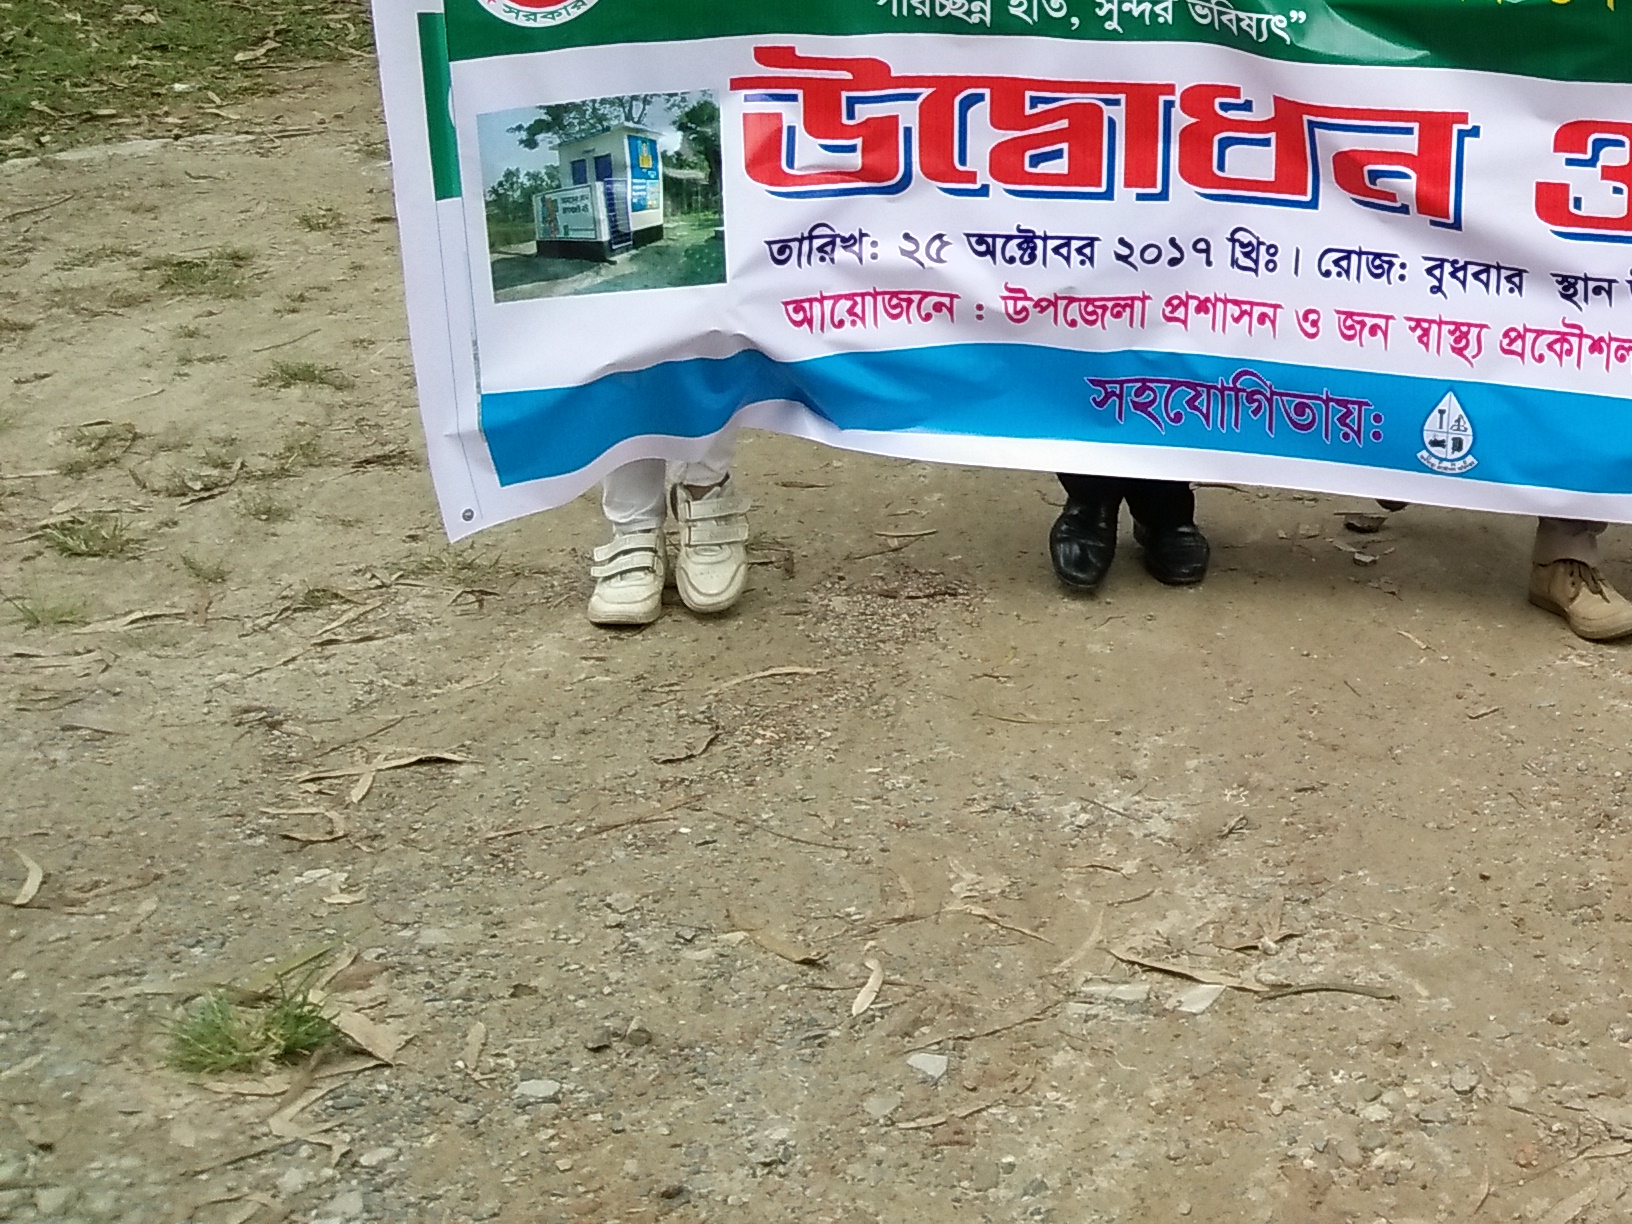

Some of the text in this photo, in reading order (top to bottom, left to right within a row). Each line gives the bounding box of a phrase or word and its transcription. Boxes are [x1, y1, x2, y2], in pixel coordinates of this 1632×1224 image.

[728, 44, 1482, 232] উদ্বোধন
[764, 225, 880, 274] তারিখ:
[899, 234, 953, 272] ২৫
[962, 225, 1101, 270] অক্টোবর
[1114, 237, 1214, 272] ২০১৭
[1316, 243, 1408, 284] রোজ:
[1424, 249, 1527, 297] বুধবার
[1550, 270, 1614, 310] স্থান
[781, 289, 959, 339] আয়োজনে
[1000, 281, 1152, 335] উপজেলা
[1161, 290, 1285, 341] প্রশাসন
[1296, 307, 1322, 341] ও
[1334, 310, 1395, 352] জন
[1405, 314, 1490, 370] স্বাস্থ্য
[1085, 370, 1384, 449] সহযোগিতায়:
